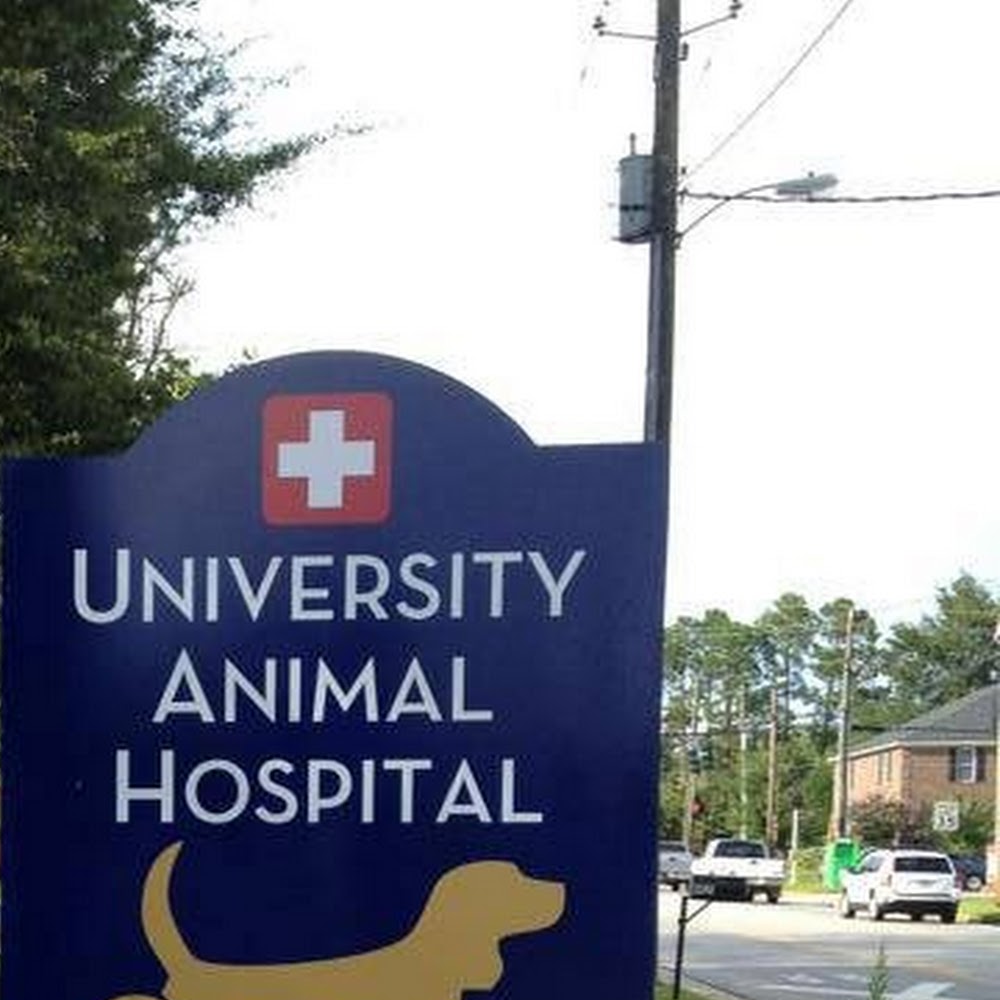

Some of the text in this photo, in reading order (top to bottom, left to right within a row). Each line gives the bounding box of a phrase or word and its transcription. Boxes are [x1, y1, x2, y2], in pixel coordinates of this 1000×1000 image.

[73, 548, 587, 625] UNIVERSITY
[152, 649, 494, 724] ANIMAL
[115, 749, 544, 825] HOSPITAL
